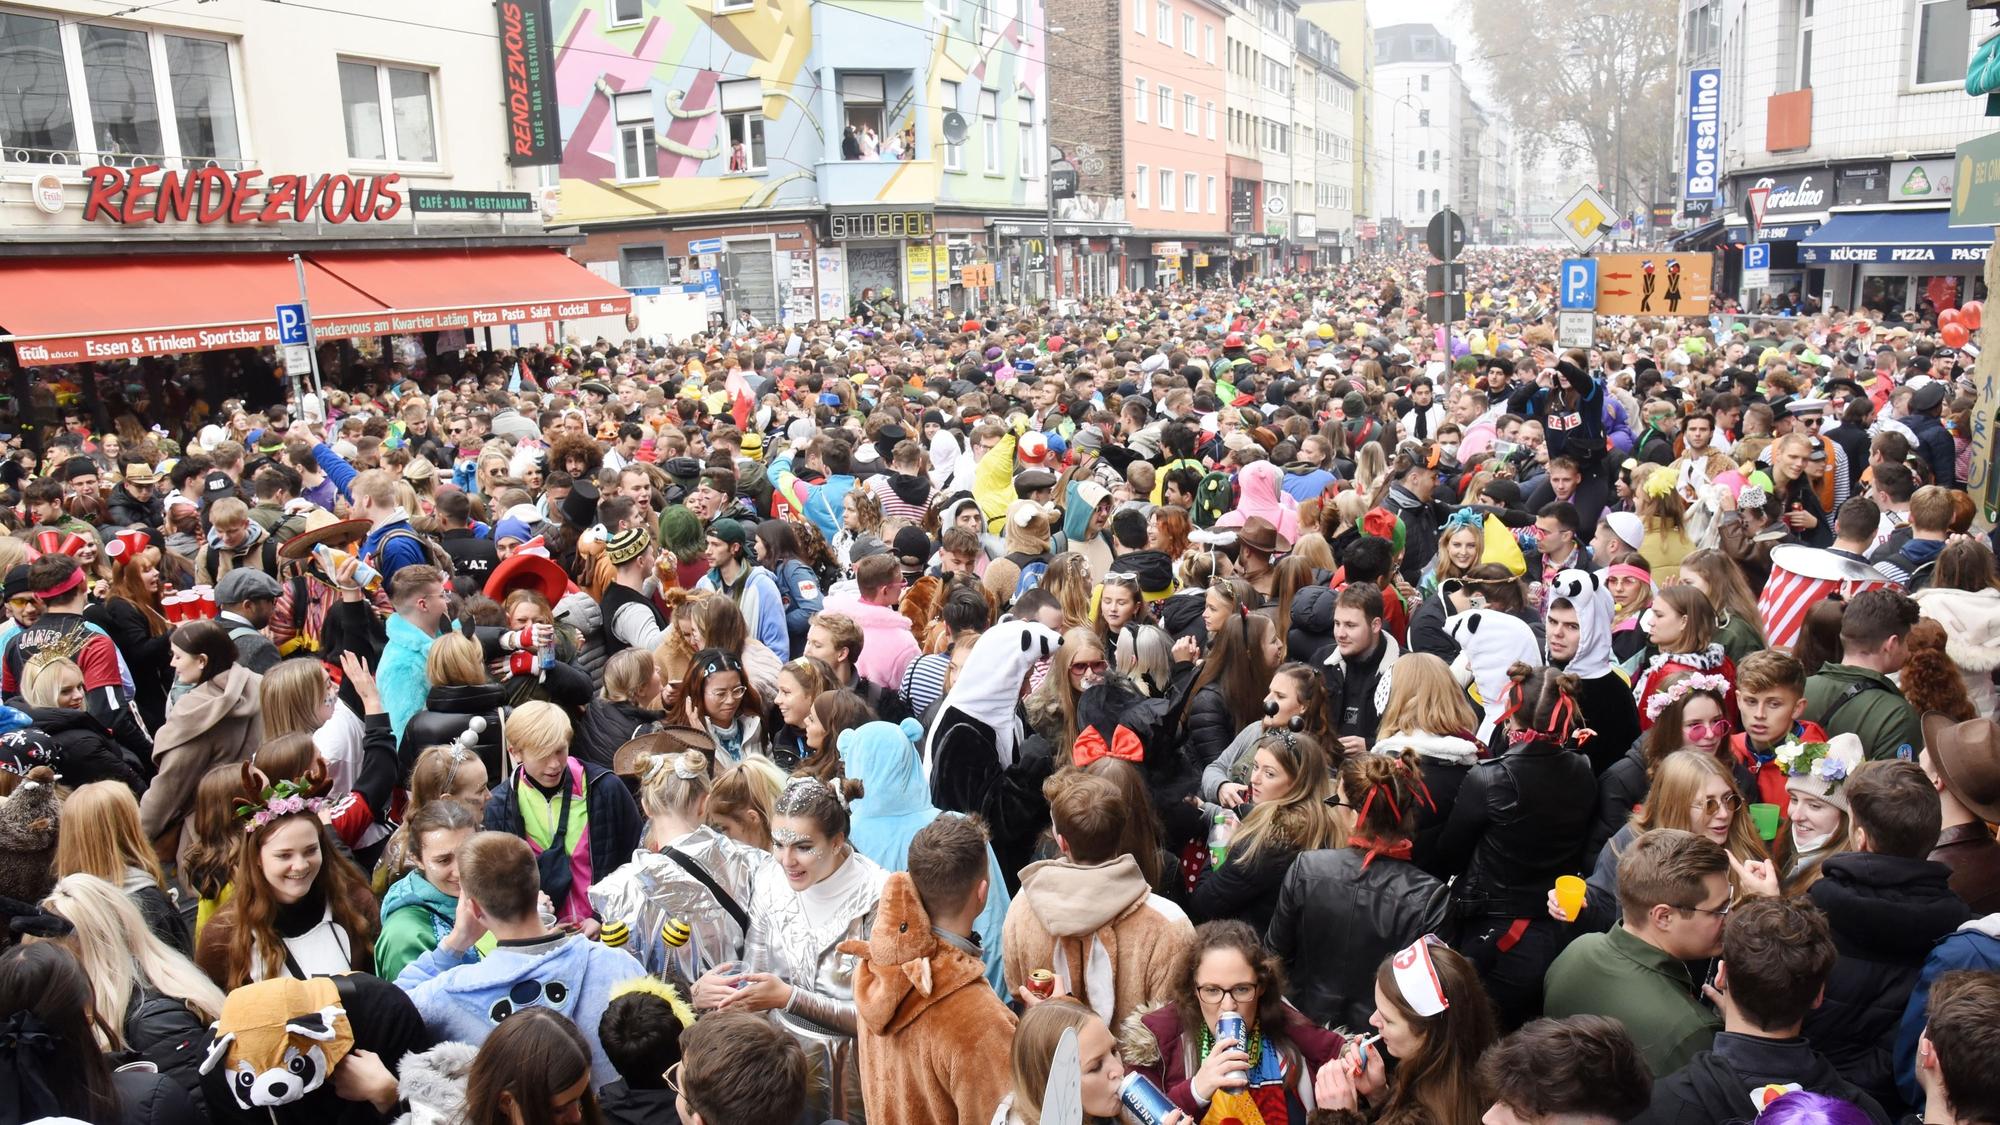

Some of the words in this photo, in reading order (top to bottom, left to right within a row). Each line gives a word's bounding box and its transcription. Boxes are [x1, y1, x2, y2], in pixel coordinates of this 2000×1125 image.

[525, 12, 540, 81] RESTAURANT
[503, 2, 533, 157] RENDEZVOUS
[533, 90, 542, 111] BAR
[535, 119, 545, 147] CAFÉ
[1689, 74, 1718, 194] Borsalino
[82, 165, 402, 224] RENDEZVOUS
[419, 194, 442, 208] CAFÉ
[450, 197, 467, 208] BAR
[475, 197, 528, 209] RESTAURANT
[1686, 200, 1708, 213] sky
[833, 214, 932, 236] STIEFEL
[1830, 247, 1878, 261] KÜCHE
[1891, 249, 1935, 261] PIZZA
[1951, 248, 1990, 260] PAST
[1568, 265, 1588, 303] P
[280, 309, 297, 339] P
[312, 318, 371, 337] endezvous
[374, 321, 389, 331] am
[392, 313, 434, 330] Kwartier
[437, 311, 468, 327] Latäng
[473, 310, 497, 323] Pizza
[502, 308, 525, 321] Pasta
[530, 305, 552, 318] Salat
[558, 303, 590, 316] Cocktail
[18, 345, 49, 360] früh
[50, 351, 79, 359] KÖLSCH
[86, 341, 129, 357] Essen
[131, 337, 144, 354] &
[145, 334, 196, 352] Trinken
[199, 327, 261, 348] Sportsbar
